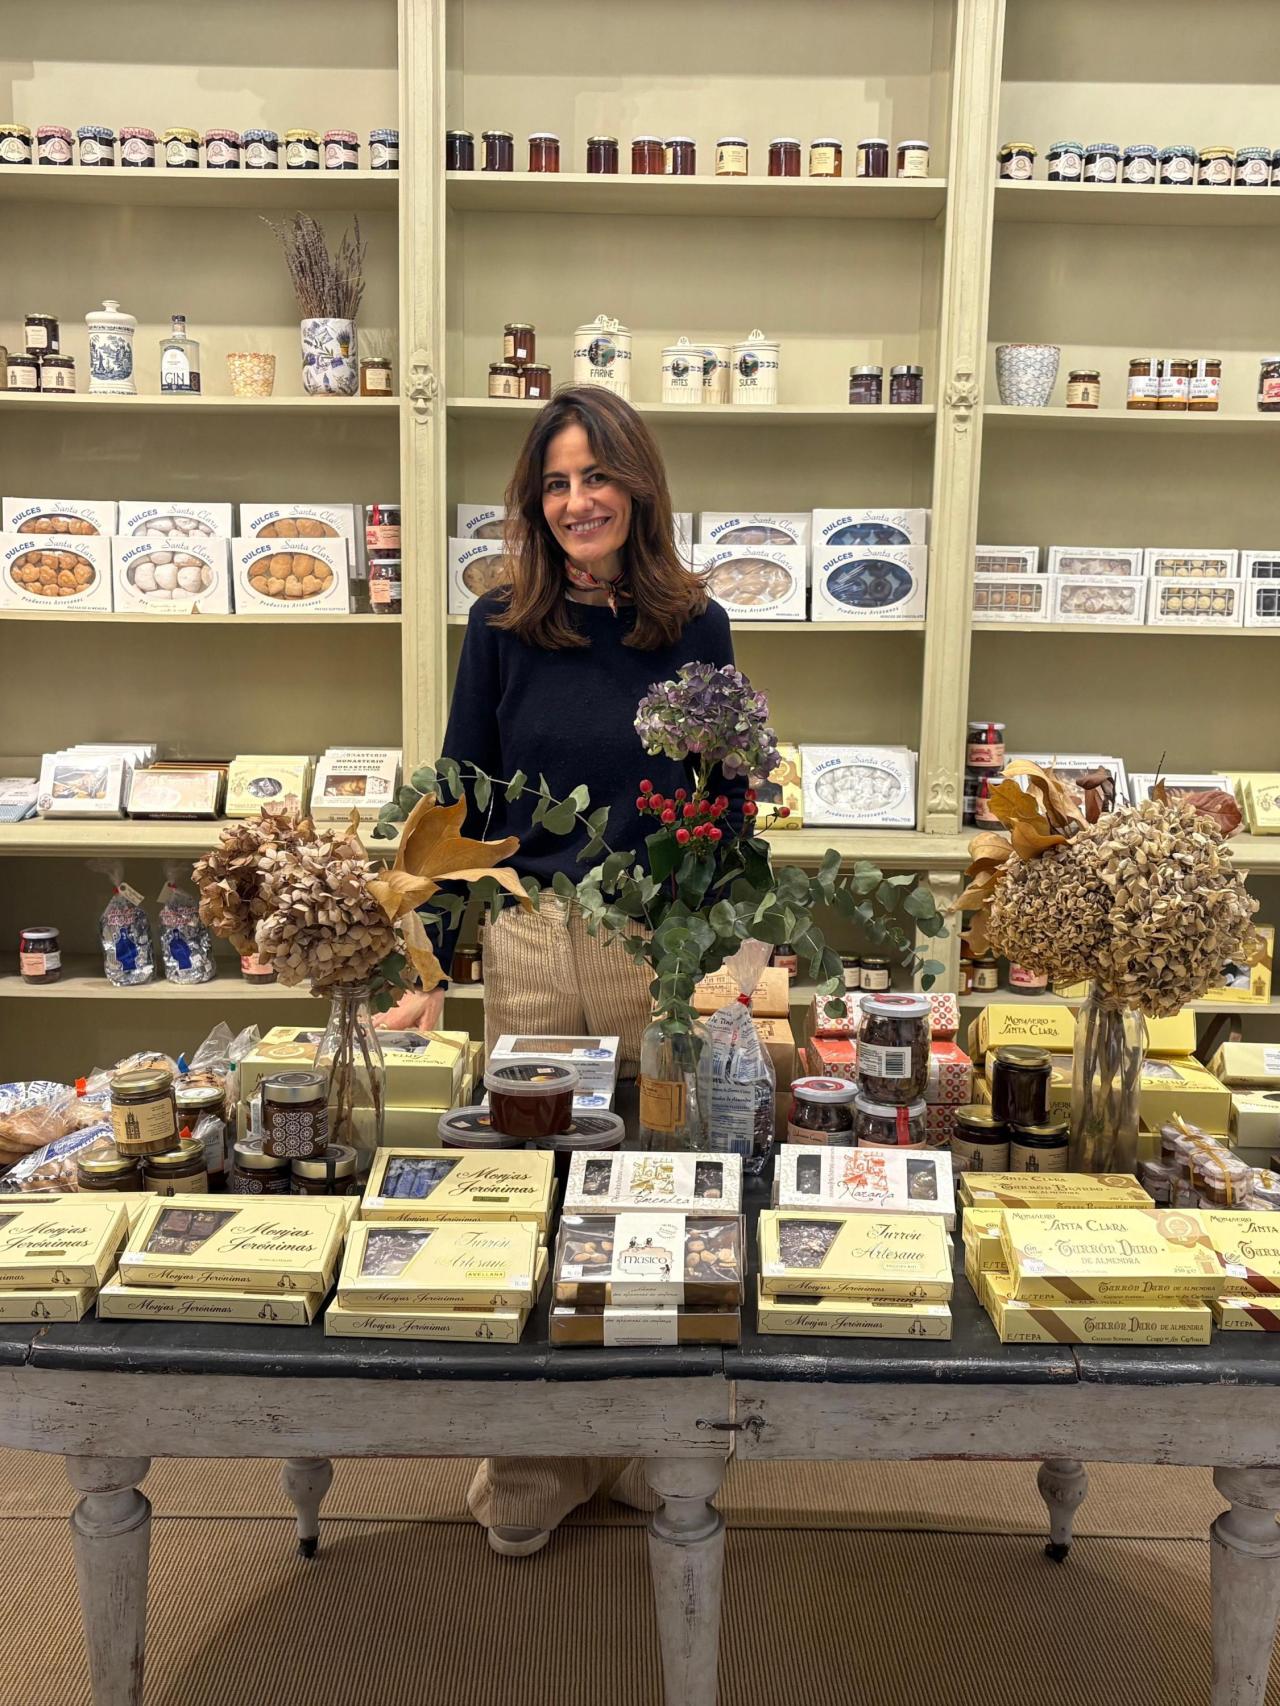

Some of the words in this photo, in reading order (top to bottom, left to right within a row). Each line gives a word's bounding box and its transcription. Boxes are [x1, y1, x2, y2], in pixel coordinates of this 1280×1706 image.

[164, 372, 184, 385] GIN
[590, 368, 614, 378] FARINE
[739, 378, 758, 387] SUCRE
[12, 506, 42, 526] DULCES
[50, 502, 78, 514] Santa
[80, 506, 102, 528] Clara
[128, 509, 158, 528] DULCES
[166, 504, 195, 515] Santa
[197, 508, 219, 529] Clara
[250, 510, 280, 530] DULCES
[289, 506, 316, 516] Santa
[466, 510, 496, 530] DULCES
[822, 516, 853, 536] DULCES
[862, 511, 890, 522] Santa
[892, 516, 913, 536] Clara
[710, 518, 741, 538] DULCES
[748, 514, 776, 525] Santa
[779, 519, 800, 539] Clara
[5, 541, 36, 560] DULCES
[44, 536, 73, 548] Santa
[75, 541, 96, 564] Clara
[122, 543, 152, 563] DULCES
[161, 538, 190, 550] Santa
[192, 543, 214, 565] Clara
[242, 544, 272, 564] DULCES
[280, 540, 308, 551] Santa
[312, 544, 334, 564] Clara
[458, 544, 488, 564] DULCES
[742, 548, 770, 558] Santa
[772, 552, 793, 571] Clara
[823, 552, 854, 572] DULCES
[862, 548, 890, 558] Santa
[892, 552, 914, 572] Clara
[850, 754, 878, 765] Santa
[880, 760, 903, 778] Clara
[998, 1024, 1027, 1035] SANTA
[456, 1167, 533, 1183] Monjas
[837, 1180, 894, 1206] Naranja
[8, 1222, 92, 1237] Monjas
[230, 1222, 314, 1238] Monjas
[1044, 1219, 1083, 1231] SANTA
[1086, 1219, 1128, 1232] CLARA
[1242, 1222, 1280, 1234] SANTA
[852, 1242, 924, 1260] Artesano
[1116, 1239, 1158, 1256] DURO
[1238, 1240, 1280, 1260] TURR
[148, 1270, 195, 1282] Monjas
[788, 1281, 831, 1290] Monjas
[128, 1299, 175, 1312] Monjas
[366, 1292, 410, 1302] Monjas
[352, 1318, 396, 1331] Monjas
[785, 1315, 828, 1328] Monjas
[1128, 1316, 1158, 1333] DURO
[1007, 1333, 1041, 1341] ESTEPA
